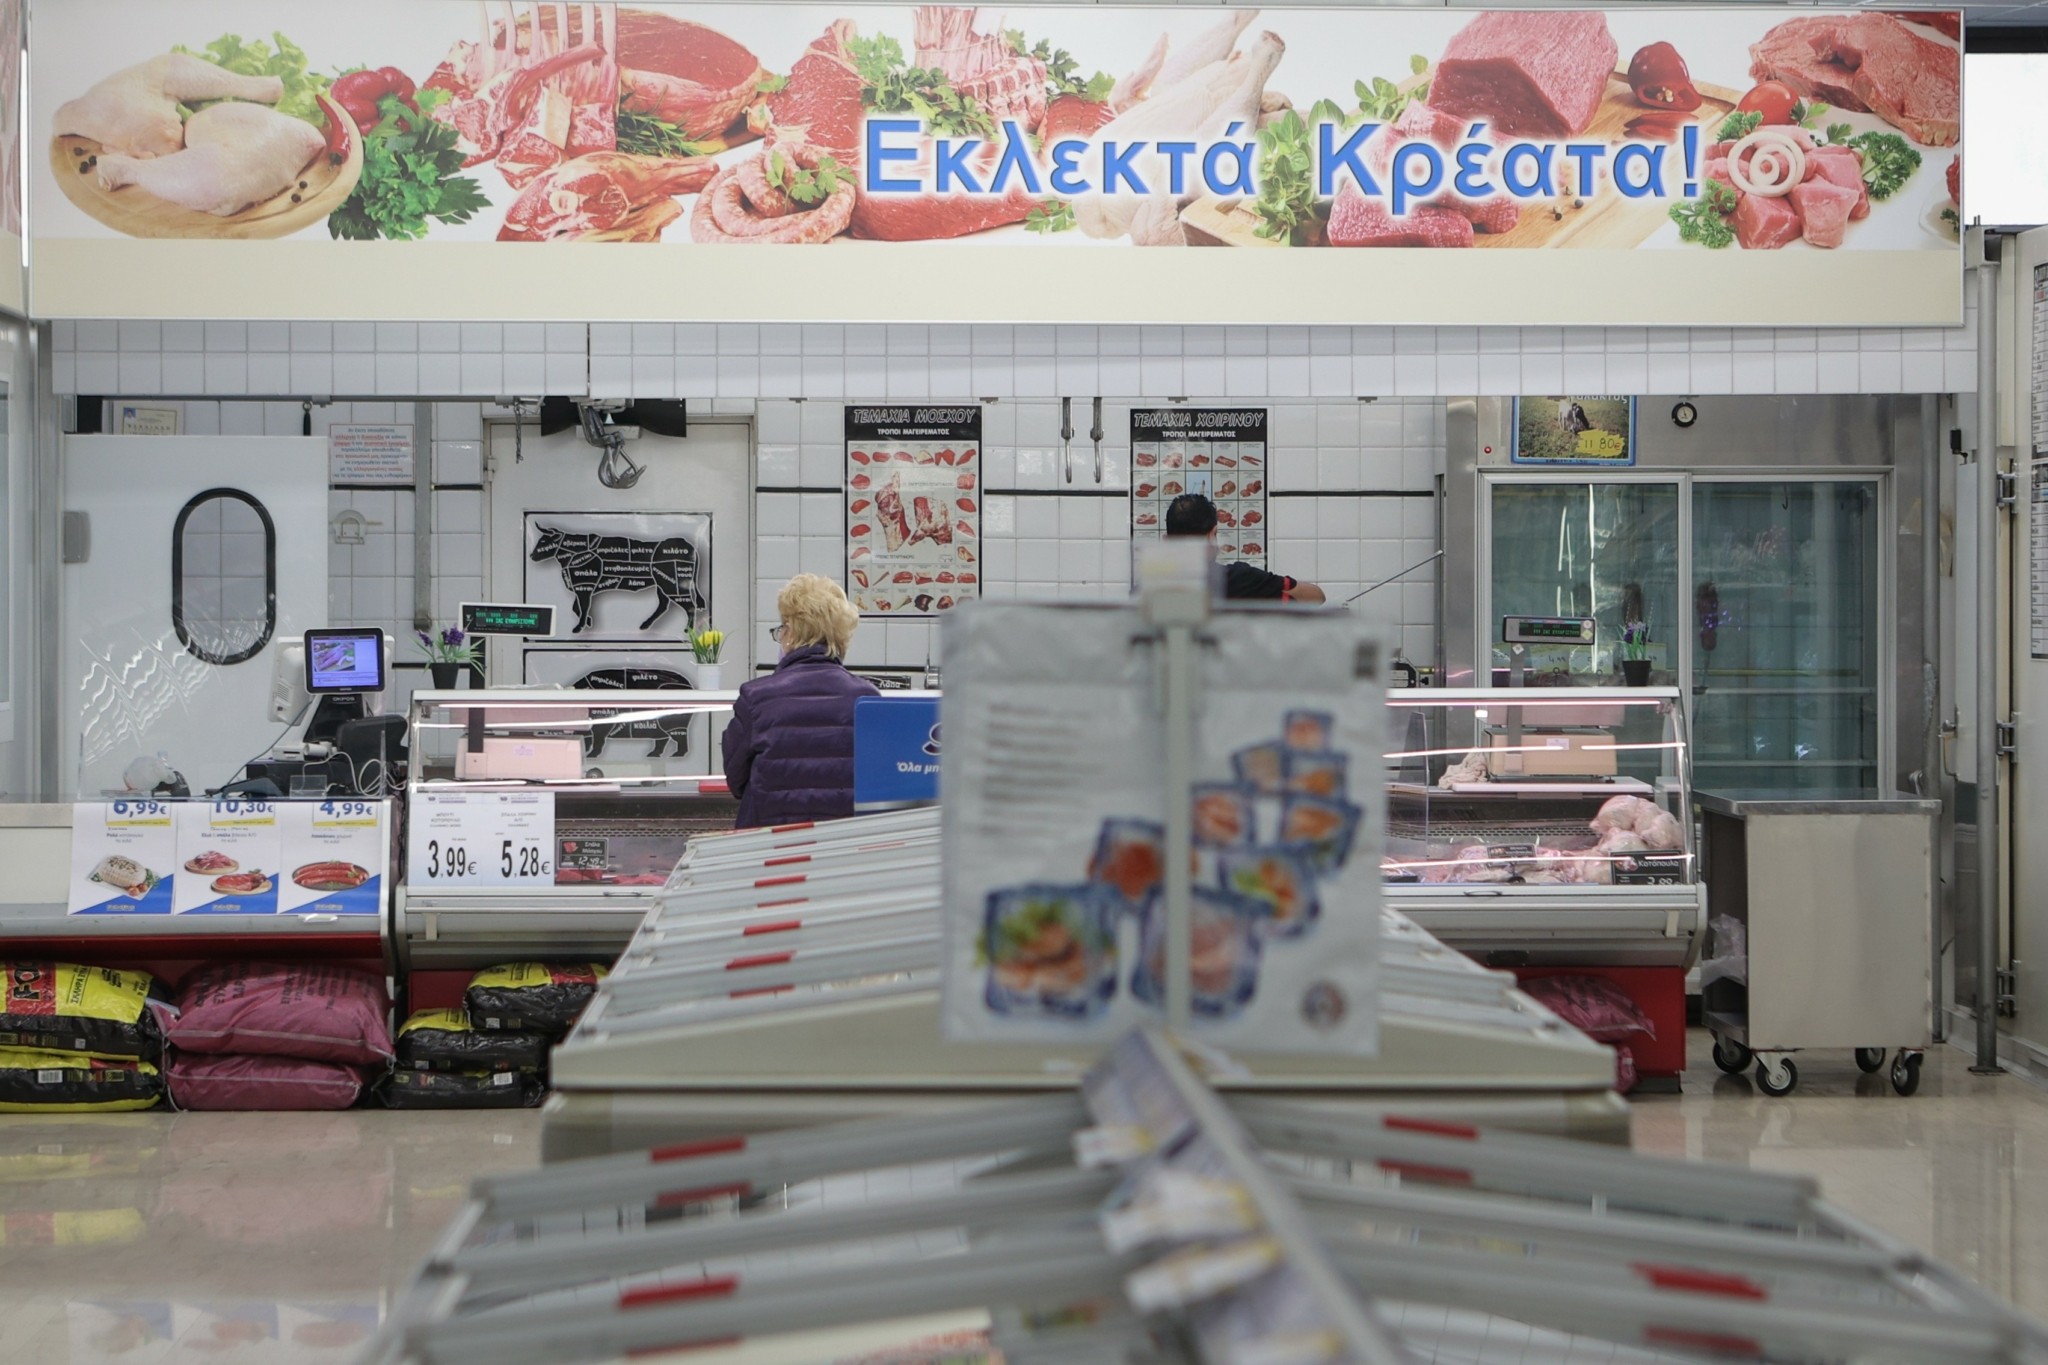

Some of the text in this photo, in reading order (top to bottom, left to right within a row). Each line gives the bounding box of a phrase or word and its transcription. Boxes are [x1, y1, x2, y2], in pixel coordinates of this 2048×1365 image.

[866, 119, 1700, 217] Εκλεκτά Κρέατα!
[854, 409, 976, 424] ΤΕΜΑΧΙΑ ΜΟΣΧΟΥ
[1134, 413, 1264, 427] ΤΕΜΑΧΙΑ ΧΟΙΡΙΝΟΥ
[877, 428, 950, 436] ΤΡΟΠΟΙ ΜΑΓΕΙΡΕΜΑΤΟΣ
[574, 569, 598, 577] σπάλα
[896, 761, 922, 773] Όλα
